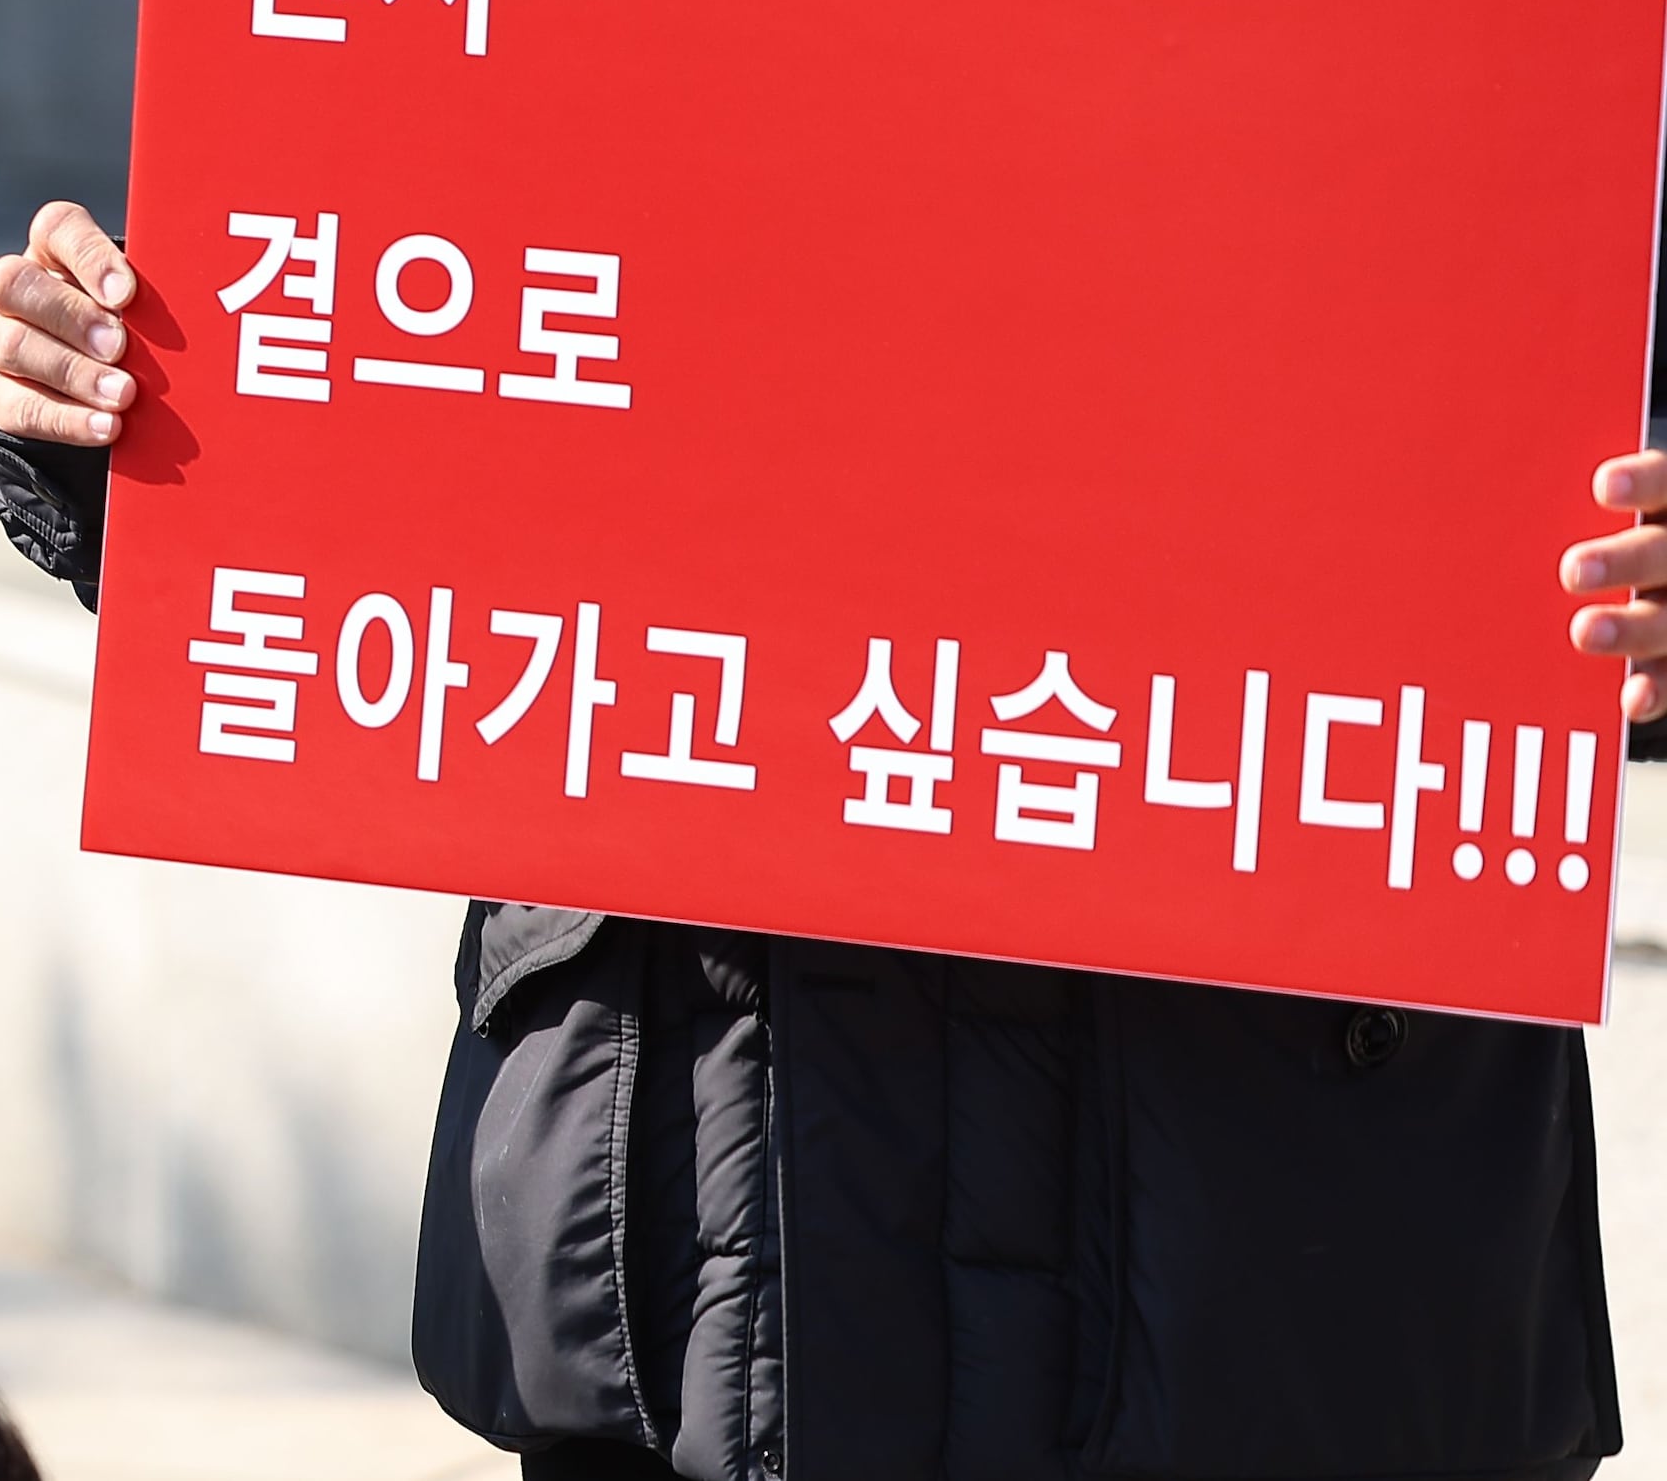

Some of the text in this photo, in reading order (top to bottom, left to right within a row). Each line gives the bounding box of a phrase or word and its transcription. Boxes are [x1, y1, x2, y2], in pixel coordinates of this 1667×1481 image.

[217, 212, 632, 409] 곁으로
[188, 567, 1597, 891] 돌아가고 싶습니다!!!
